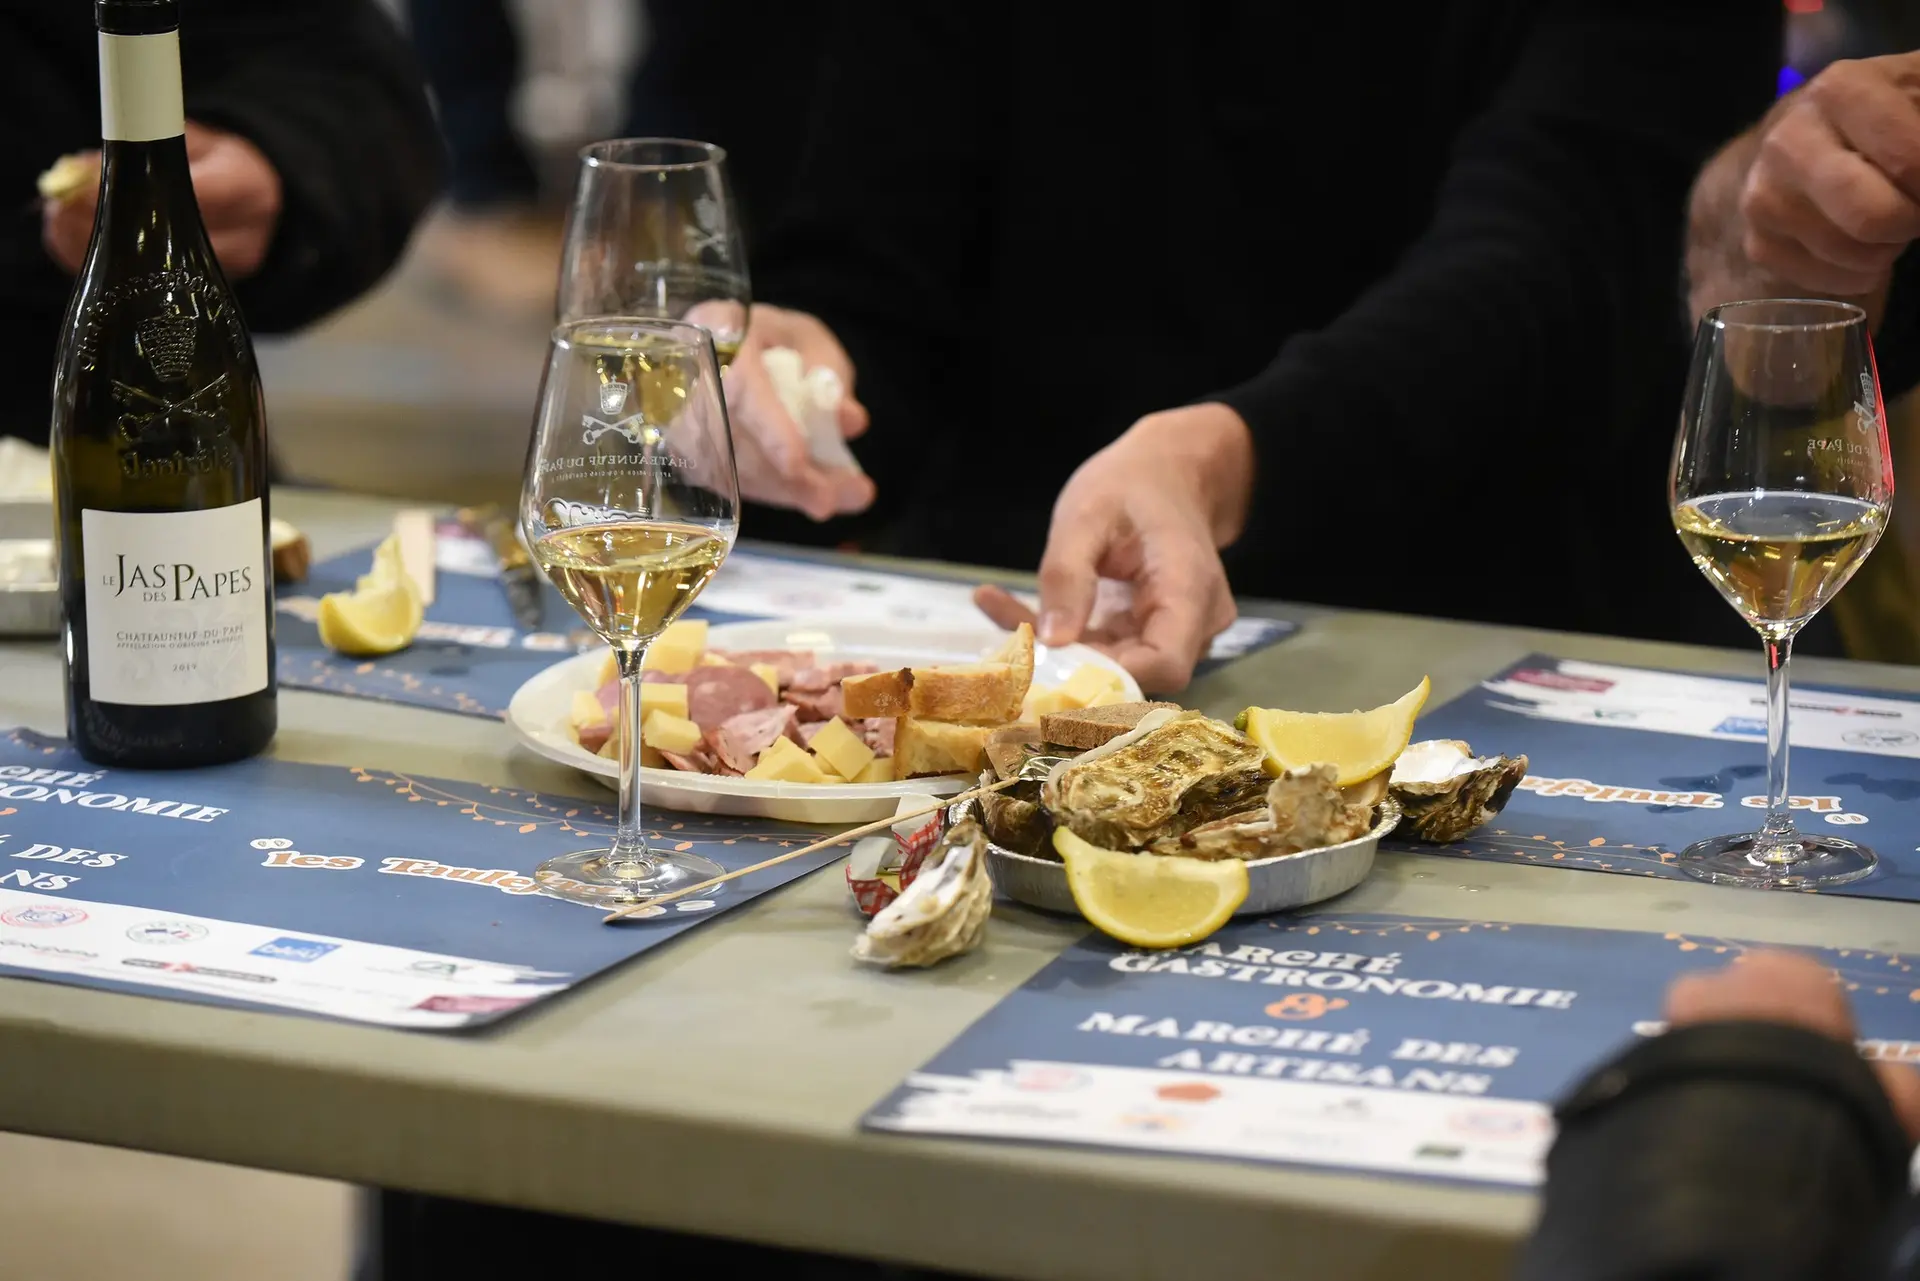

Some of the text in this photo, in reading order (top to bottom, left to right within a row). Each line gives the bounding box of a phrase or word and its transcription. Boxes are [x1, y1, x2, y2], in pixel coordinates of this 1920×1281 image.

[102, 553, 252, 602] LE JAS DES PAPES
[0, 780, 230, 823] ONOMIE
[10, 843, 129, 868] DES
[263, 850, 364, 869] les
[1109, 953, 1578, 1009] GASTRONOMIE
[1165, 942, 1402, 975] ARCHÉ
[1075, 1011, 1520, 1068] MARCHÉ DES
[1156, 1048, 1494, 1096] ARTISANS
